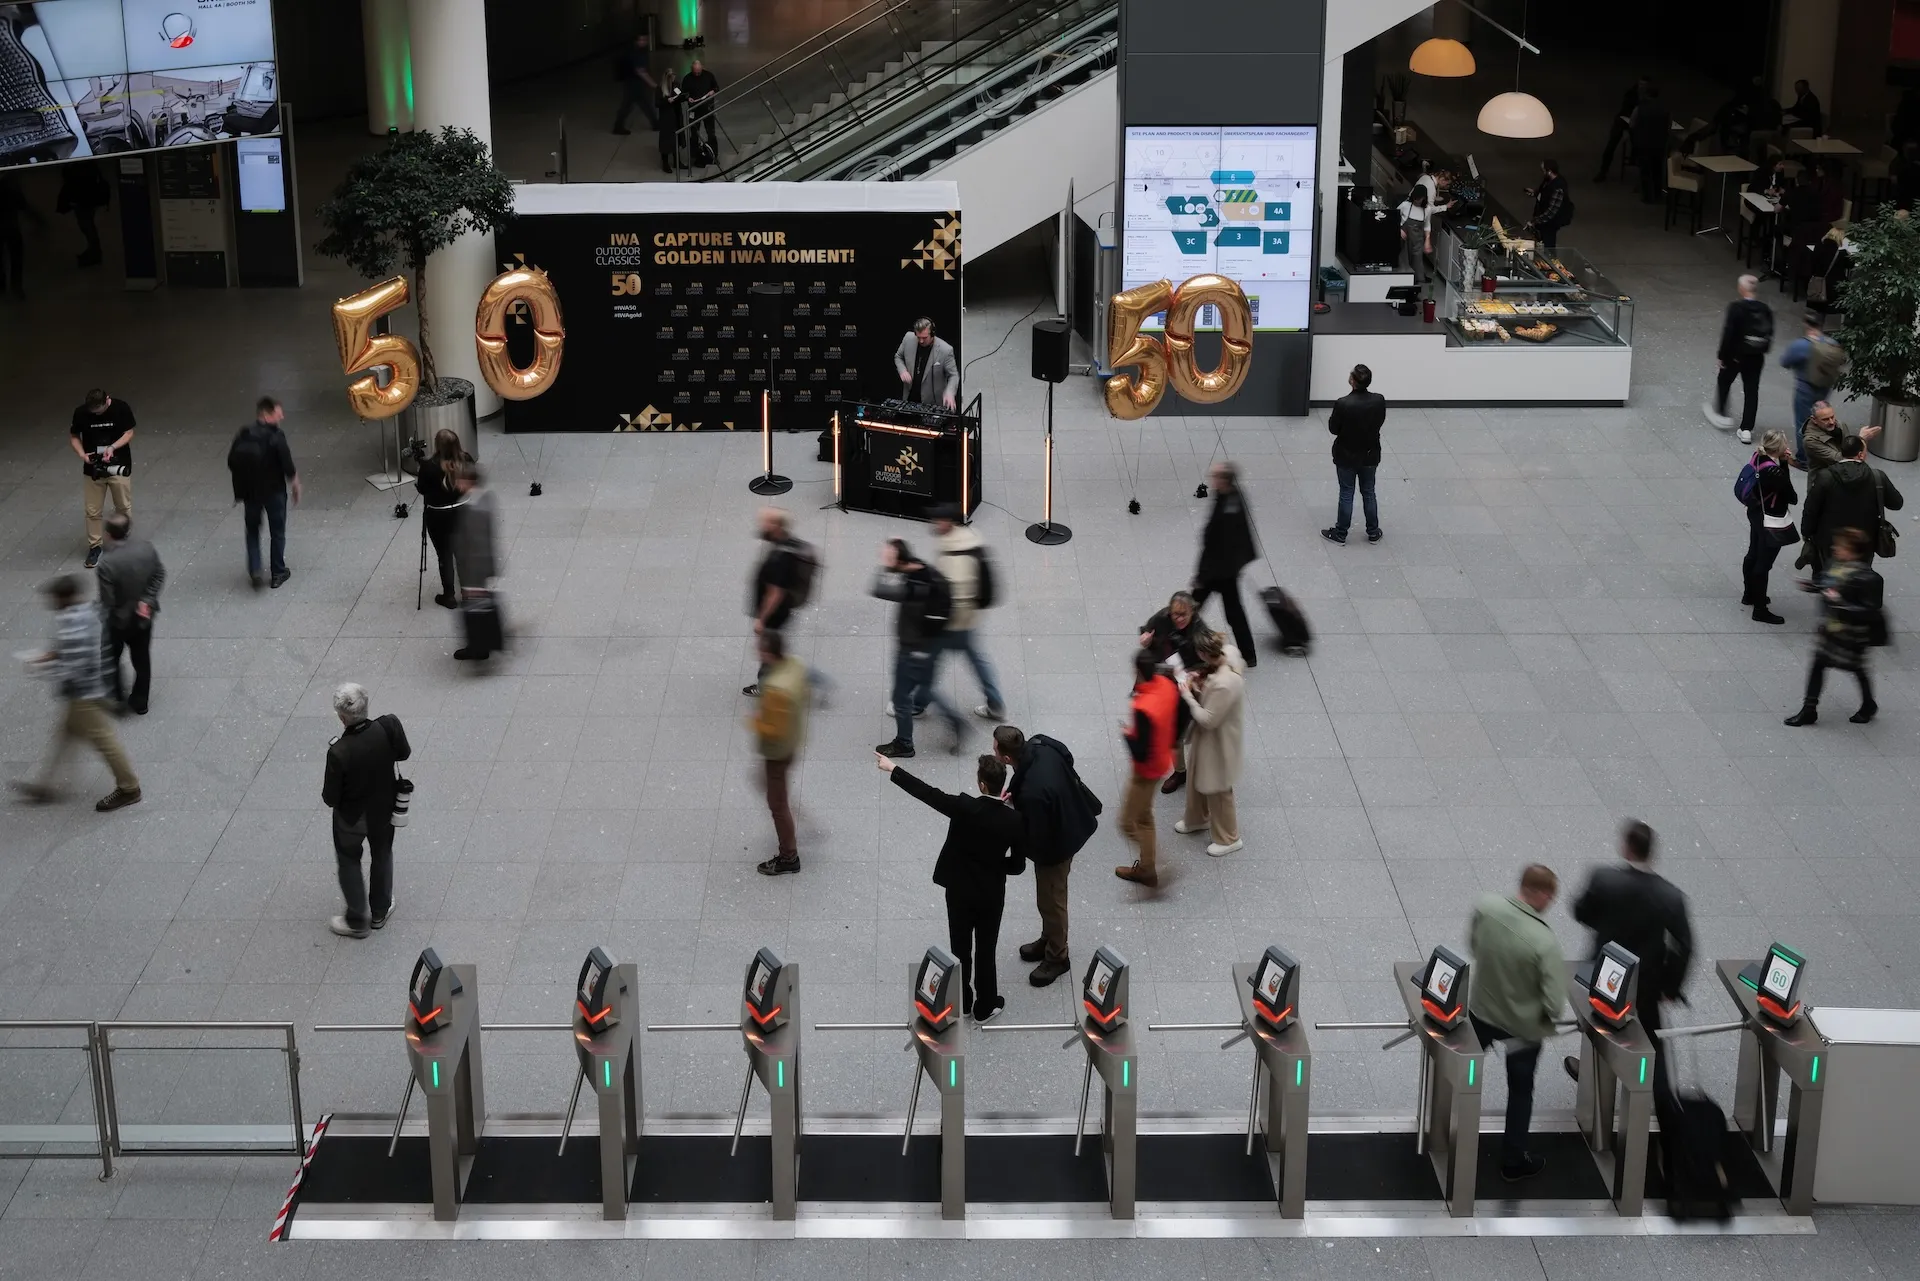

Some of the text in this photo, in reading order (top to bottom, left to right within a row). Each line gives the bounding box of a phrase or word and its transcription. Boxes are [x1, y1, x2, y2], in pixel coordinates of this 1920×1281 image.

[611, 233, 640, 246] IWA
[654, 231, 786, 246] CAPTURE YOUR
[596, 247, 640, 256] OUTDOOR
[654, 249, 855, 264] GOLDEN IWA MOMENT!
[596, 256, 640, 265] CLASSICS
[612, 274, 641, 295] 50
[1104, 273, 1253, 420] 50
[884, 465, 900, 473] IWA
[1772, 971, 1787, 988] GO
